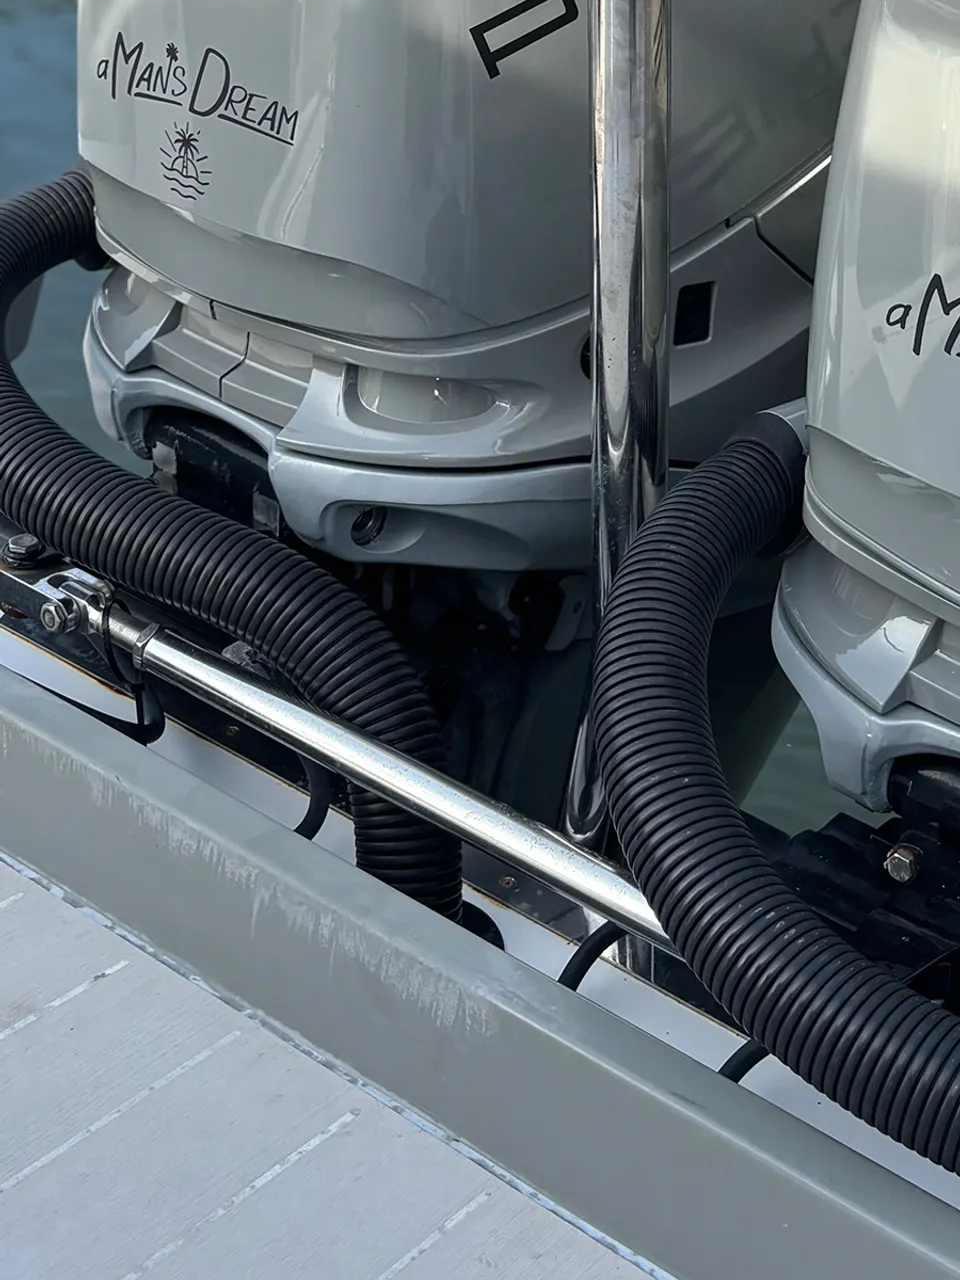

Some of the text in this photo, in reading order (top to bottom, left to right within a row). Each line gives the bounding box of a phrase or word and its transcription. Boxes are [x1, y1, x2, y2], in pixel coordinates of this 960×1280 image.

[96, 58, 109, 82] a
[188, 47, 299, 145] DREAM
[885, 302, 912, 330] a
